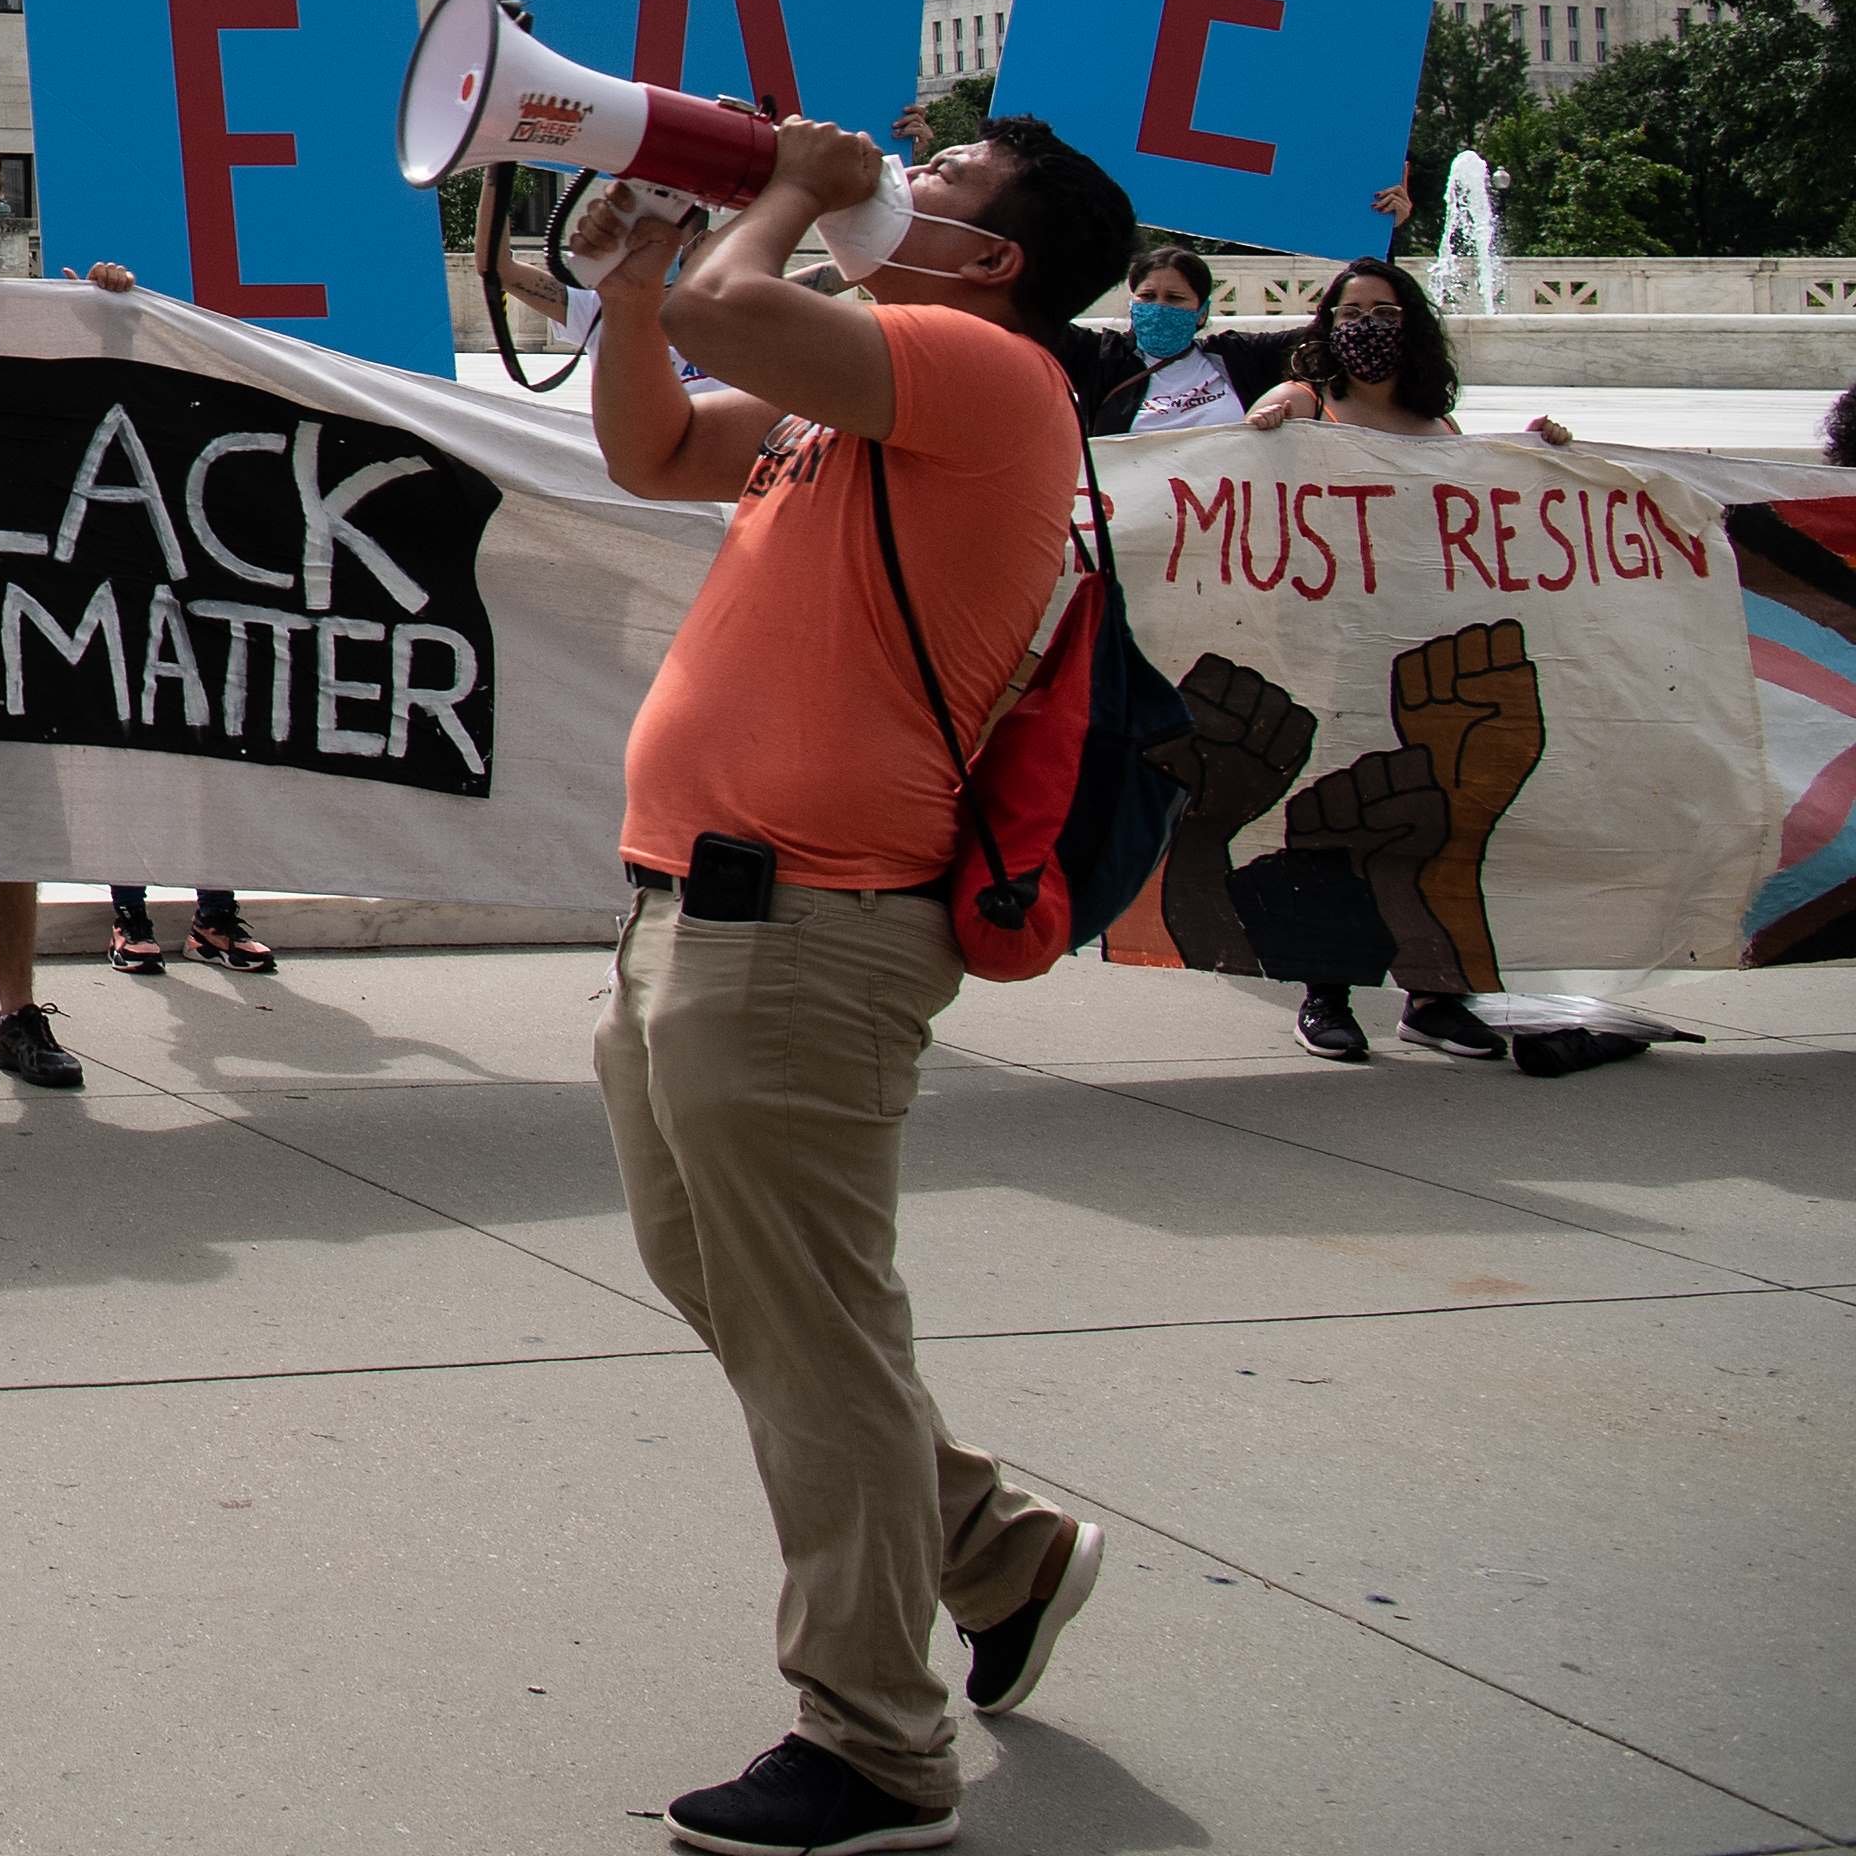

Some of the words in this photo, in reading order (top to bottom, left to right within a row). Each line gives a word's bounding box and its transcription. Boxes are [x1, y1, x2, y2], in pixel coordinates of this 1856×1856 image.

[1165, 476, 1396, 601] MUST
[1432, 484, 1709, 593] RESIGN
[0, 580, 486, 775] MATTER
